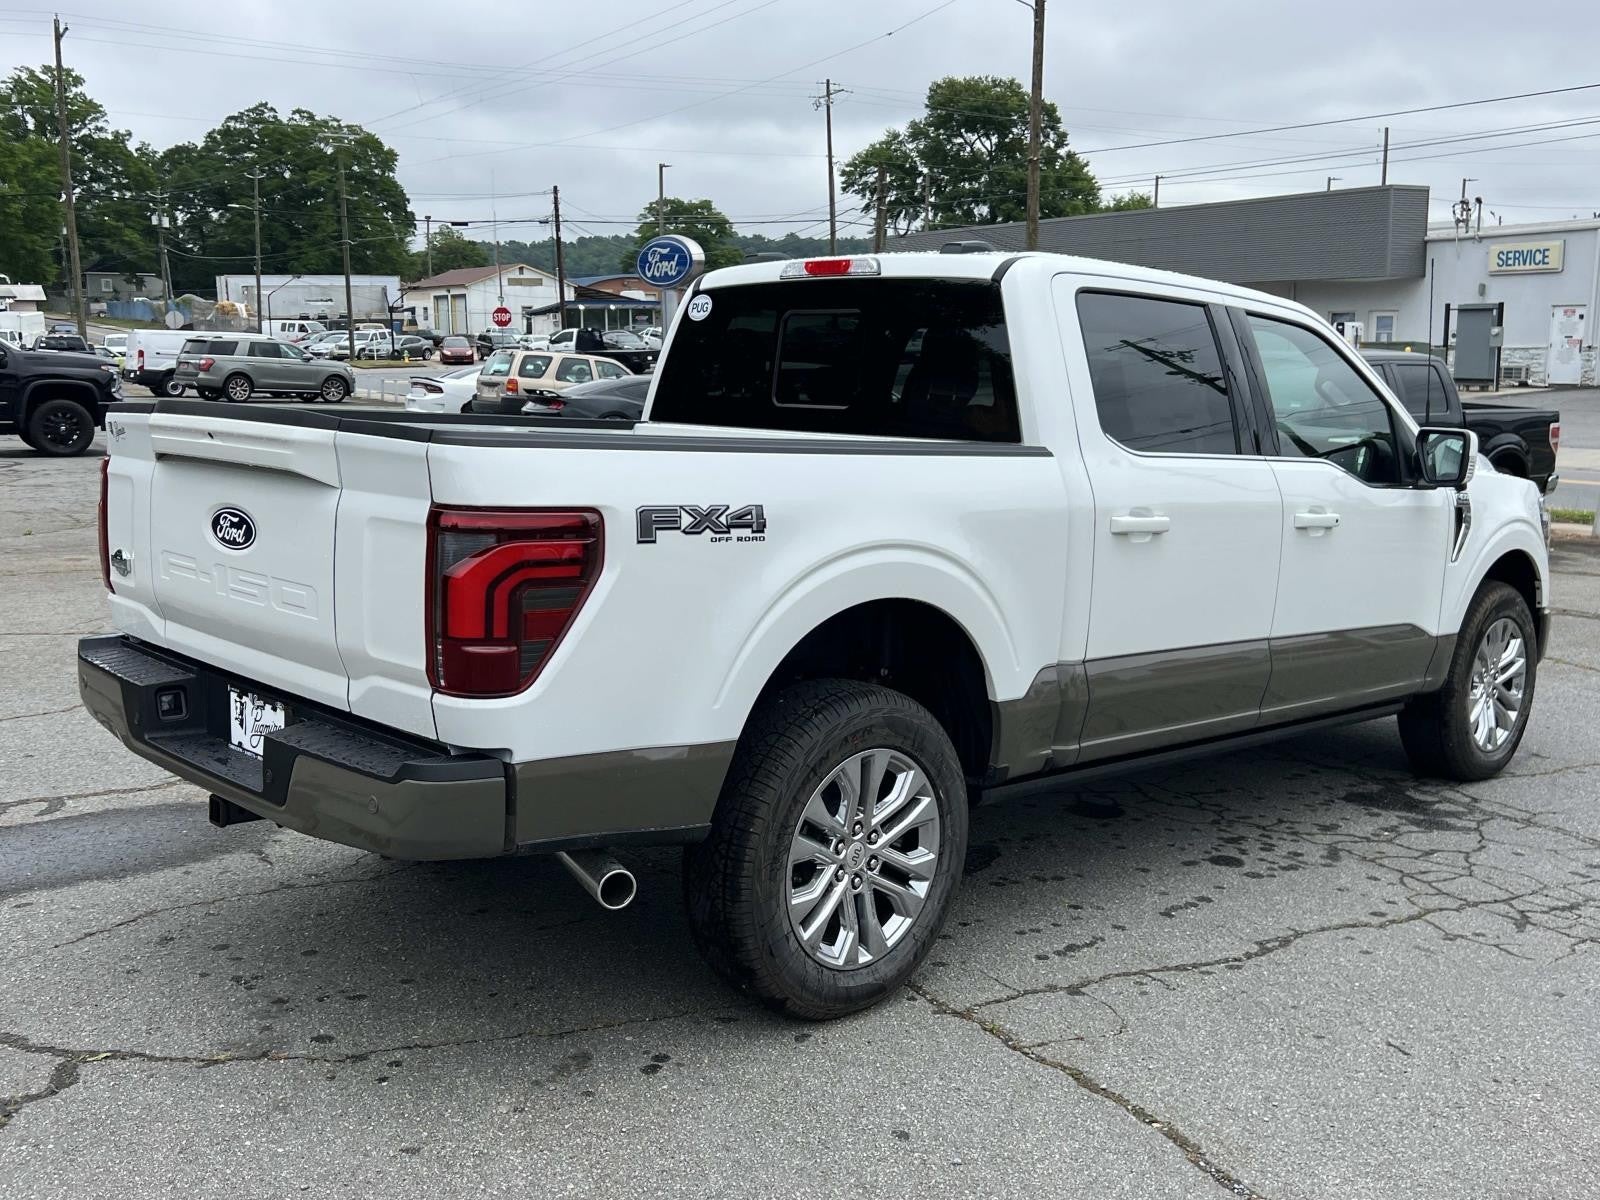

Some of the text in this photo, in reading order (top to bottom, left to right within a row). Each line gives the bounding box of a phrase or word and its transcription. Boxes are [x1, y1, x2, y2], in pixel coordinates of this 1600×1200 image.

[645, 247, 679, 278] Ford
[1496, 248, 1551, 268] SERVICE
[493, 312, 511, 322] STOP
[691, 302, 709, 313] PUG
[216, 513, 246, 543] Ford
[636, 505, 767, 544] FX4
[161, 550, 319, 621] F-150
